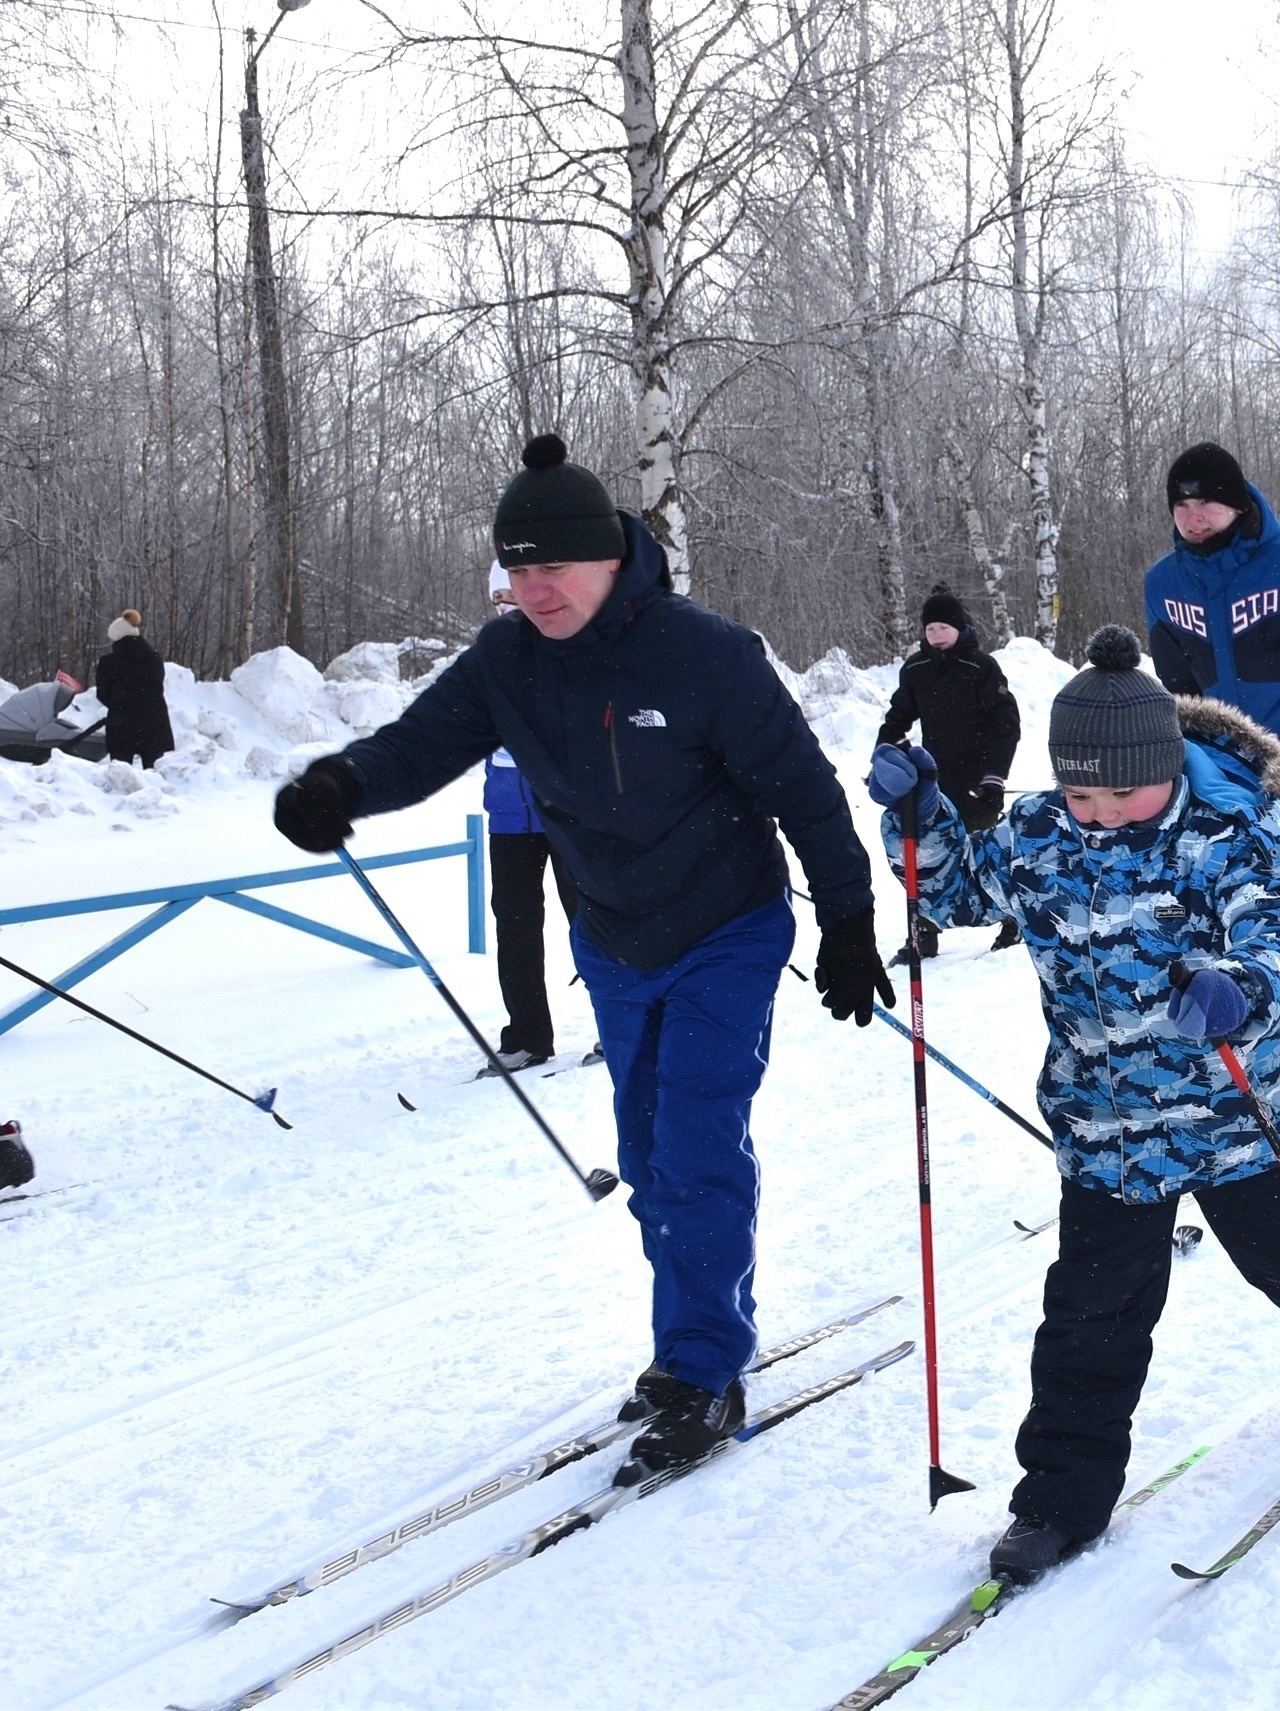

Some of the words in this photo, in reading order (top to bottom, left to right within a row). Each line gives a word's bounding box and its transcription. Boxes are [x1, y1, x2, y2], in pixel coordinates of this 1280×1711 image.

[1164, 599, 1208, 638] RUS
[1231, 588, 1279, 635] SIA
[1056, 756, 1101, 774] EVERLAST
[765, 1323, 848, 1362] SPORT
[768, 1373, 859, 1416] SPORT
[320, 1479, 502, 1580] SABLE
[293, 1559, 489, 1681] SABLE
